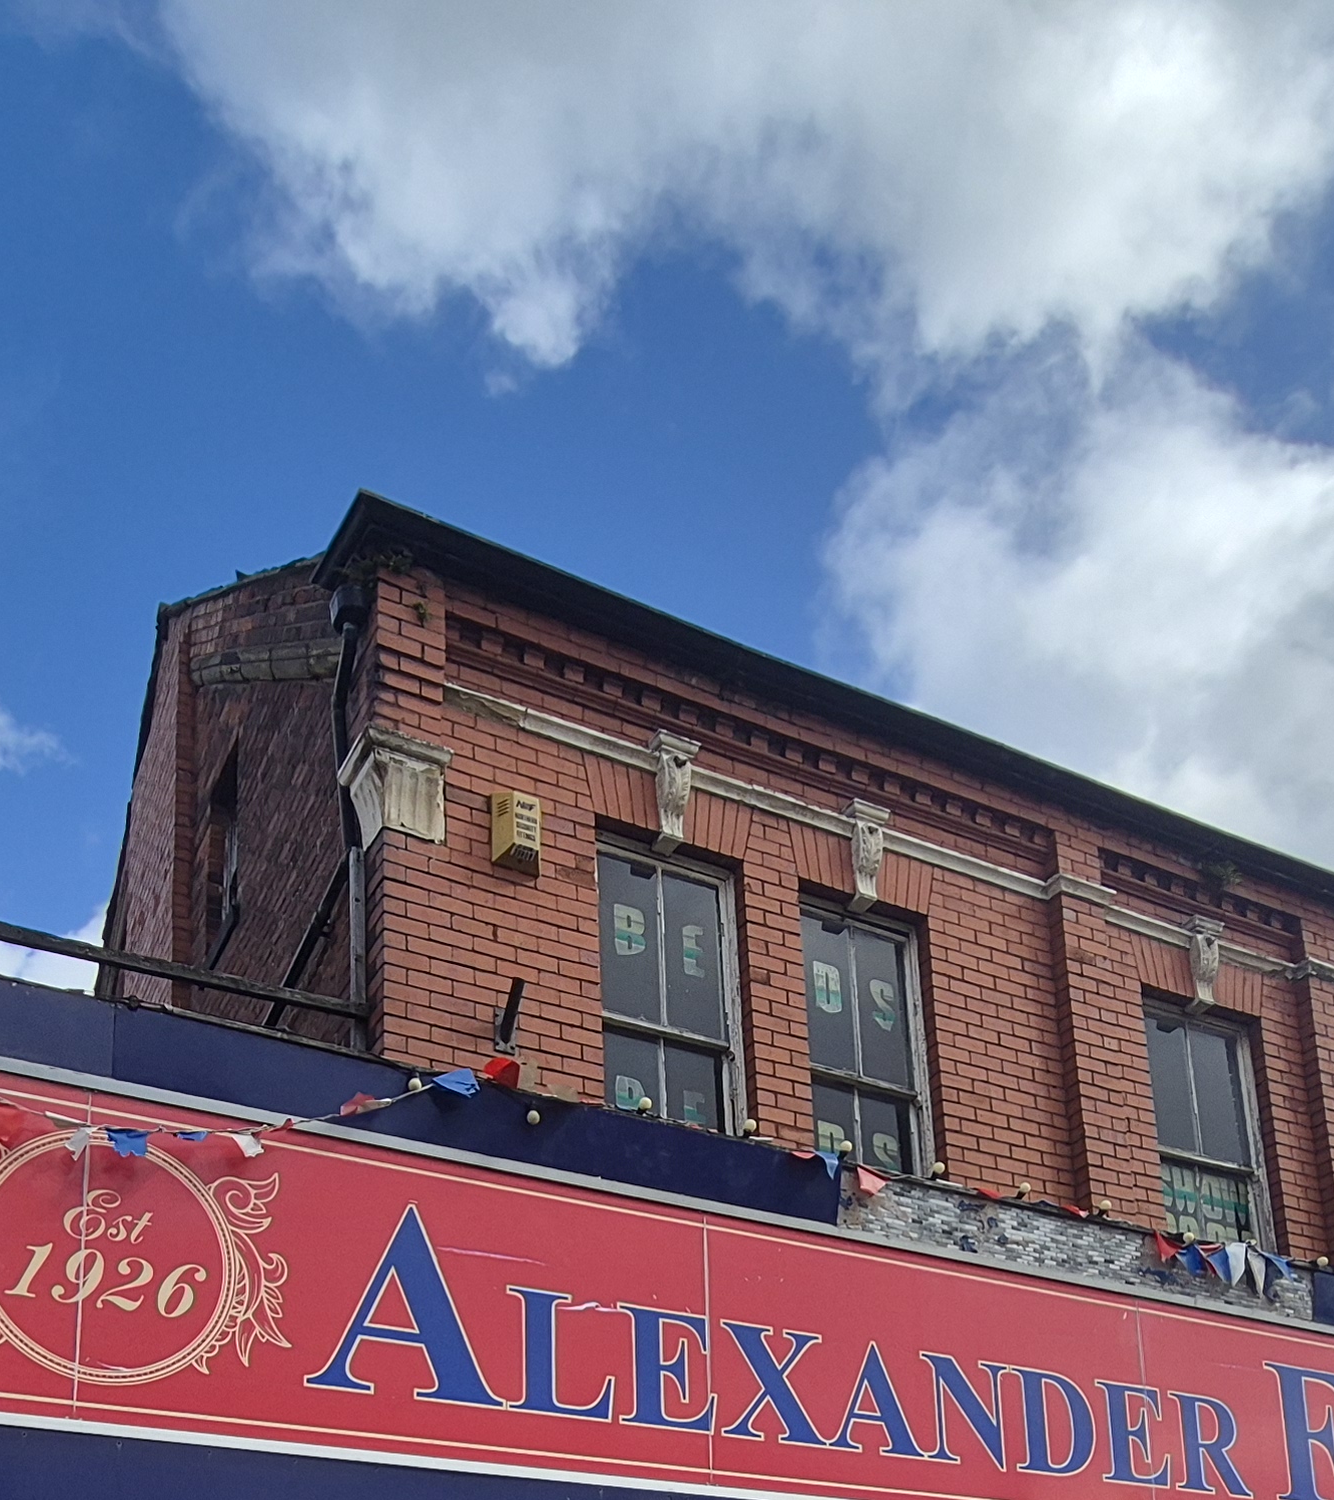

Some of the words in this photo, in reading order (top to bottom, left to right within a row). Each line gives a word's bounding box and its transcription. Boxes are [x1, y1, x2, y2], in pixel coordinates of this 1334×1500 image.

[62, 1188, 153, 1245] Est
[4, 1242, 207, 1319] 1926
[303, 1200, 1255, 1500] ALEXANDER
